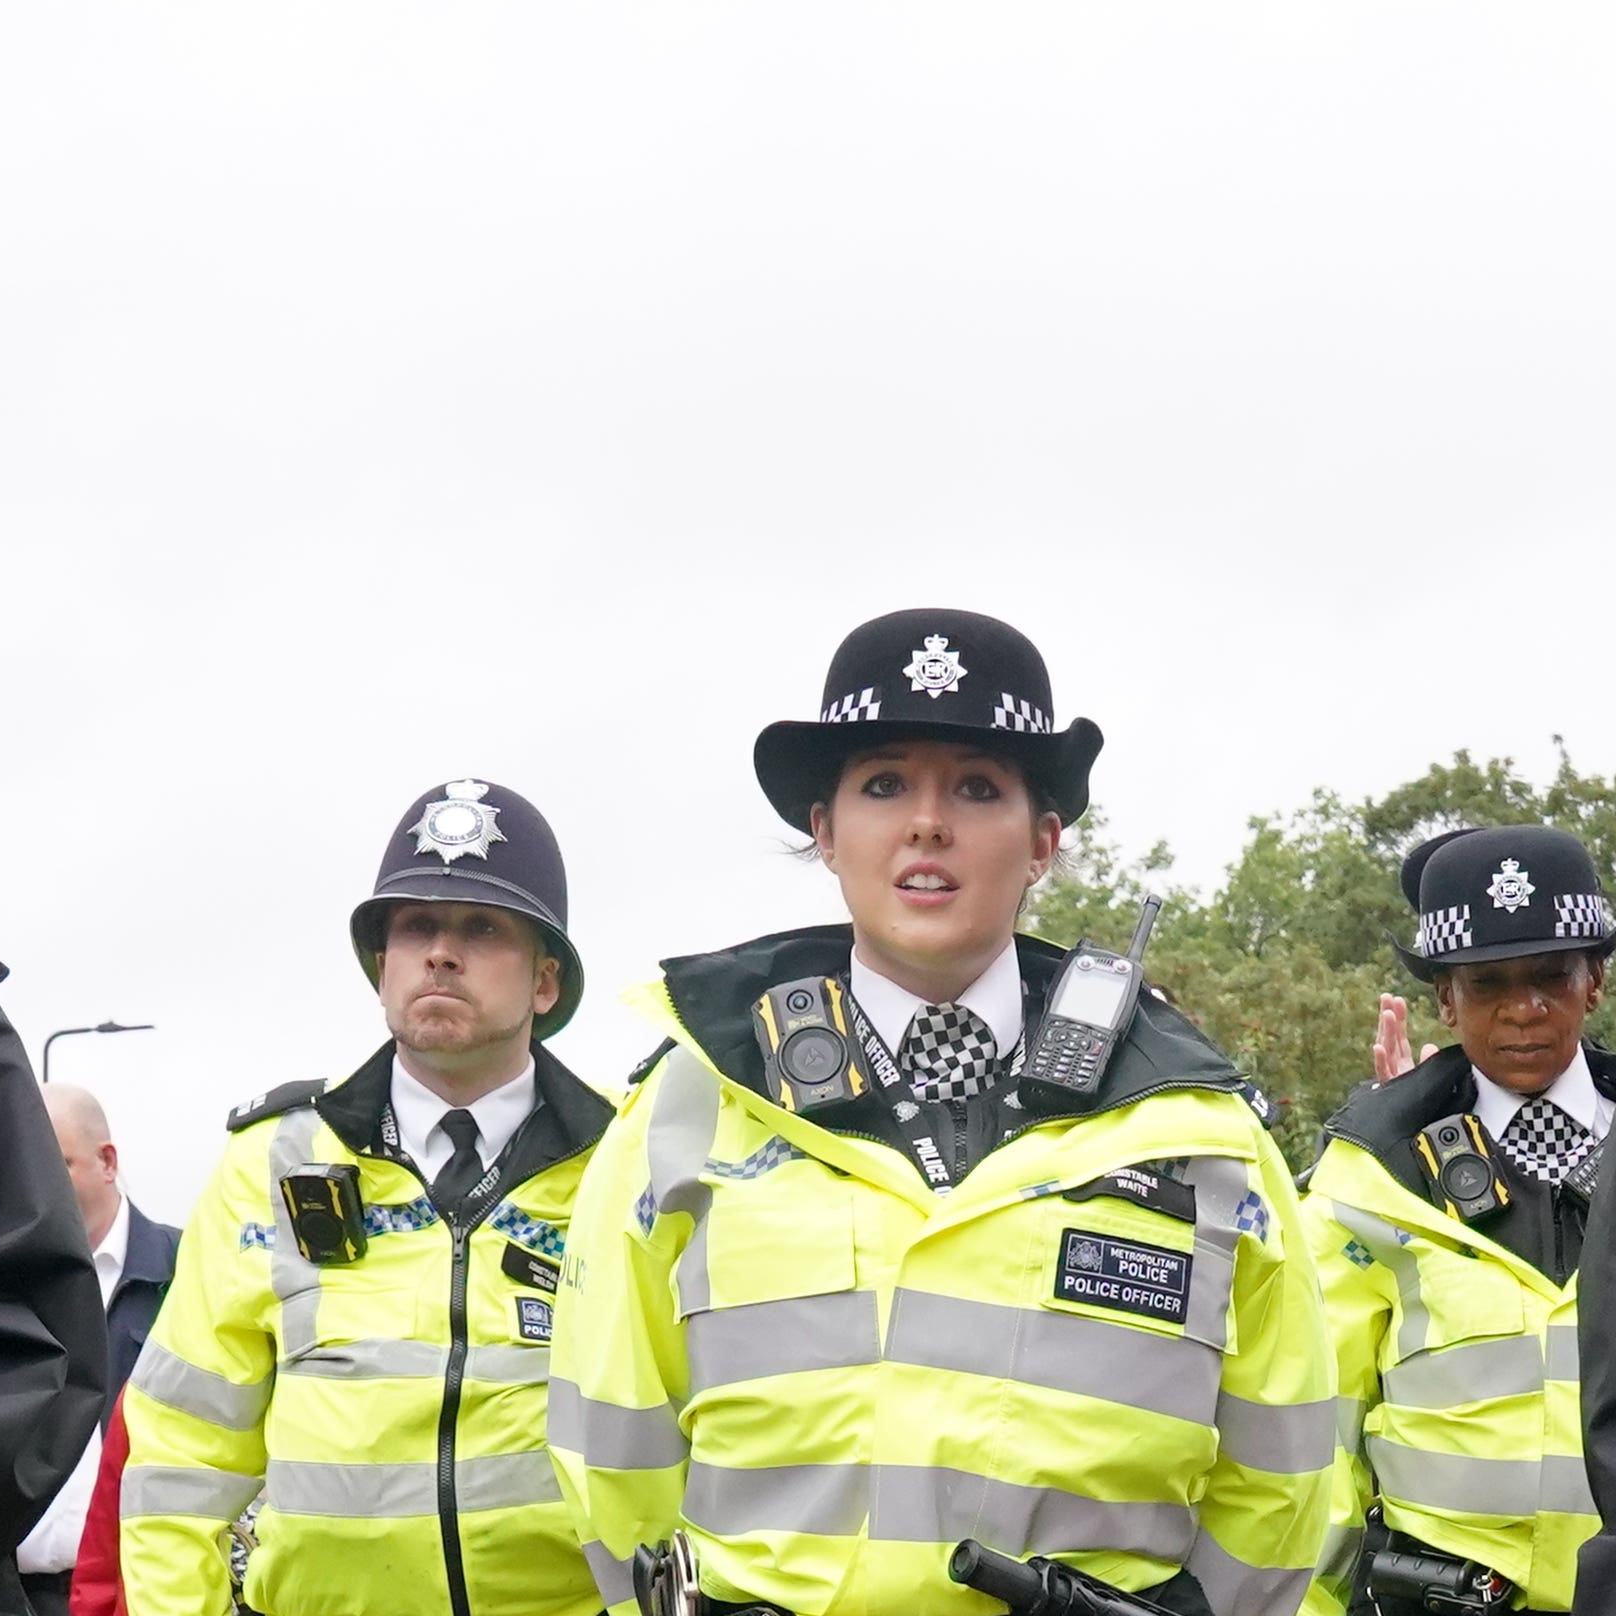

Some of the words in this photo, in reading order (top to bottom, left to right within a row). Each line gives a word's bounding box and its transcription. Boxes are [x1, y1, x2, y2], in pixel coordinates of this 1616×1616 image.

[848, 995, 871, 1044] OLICE
[864, 1035, 901, 1088] OFFICER
[913, 1136, 950, 1184] POLICE
[1110, 1247, 1178, 1271] METROPOLITAN
[1119, 1260, 1169, 1284] POLICE
[1064, 1275, 1120, 1300] POLICE
[1122, 1286, 1182, 1314] OFFICER
